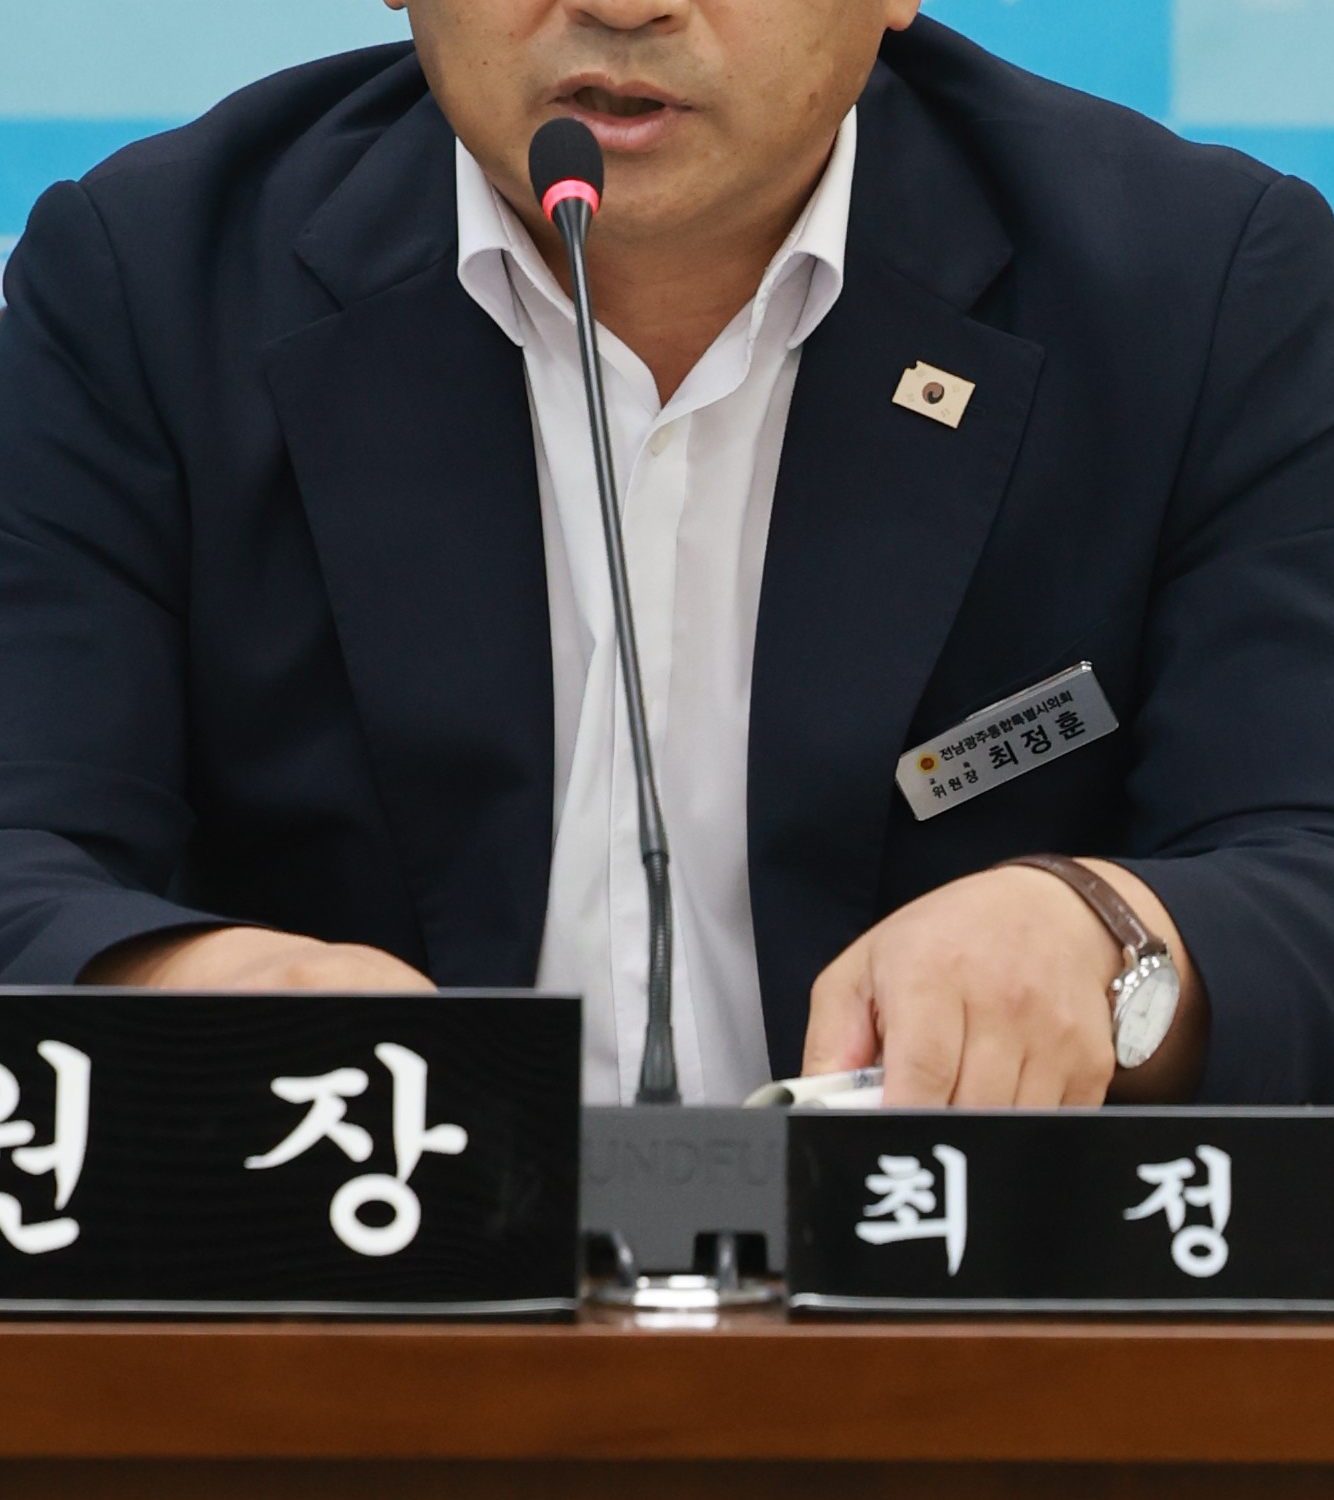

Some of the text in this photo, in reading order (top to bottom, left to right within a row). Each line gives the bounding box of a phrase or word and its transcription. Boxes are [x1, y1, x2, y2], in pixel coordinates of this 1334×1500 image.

[939, 690, 1073, 761] 전남광주통합특별시의회
[989, 710, 1085, 769] 최정훈
[932, 769, 979, 798] 위원장
